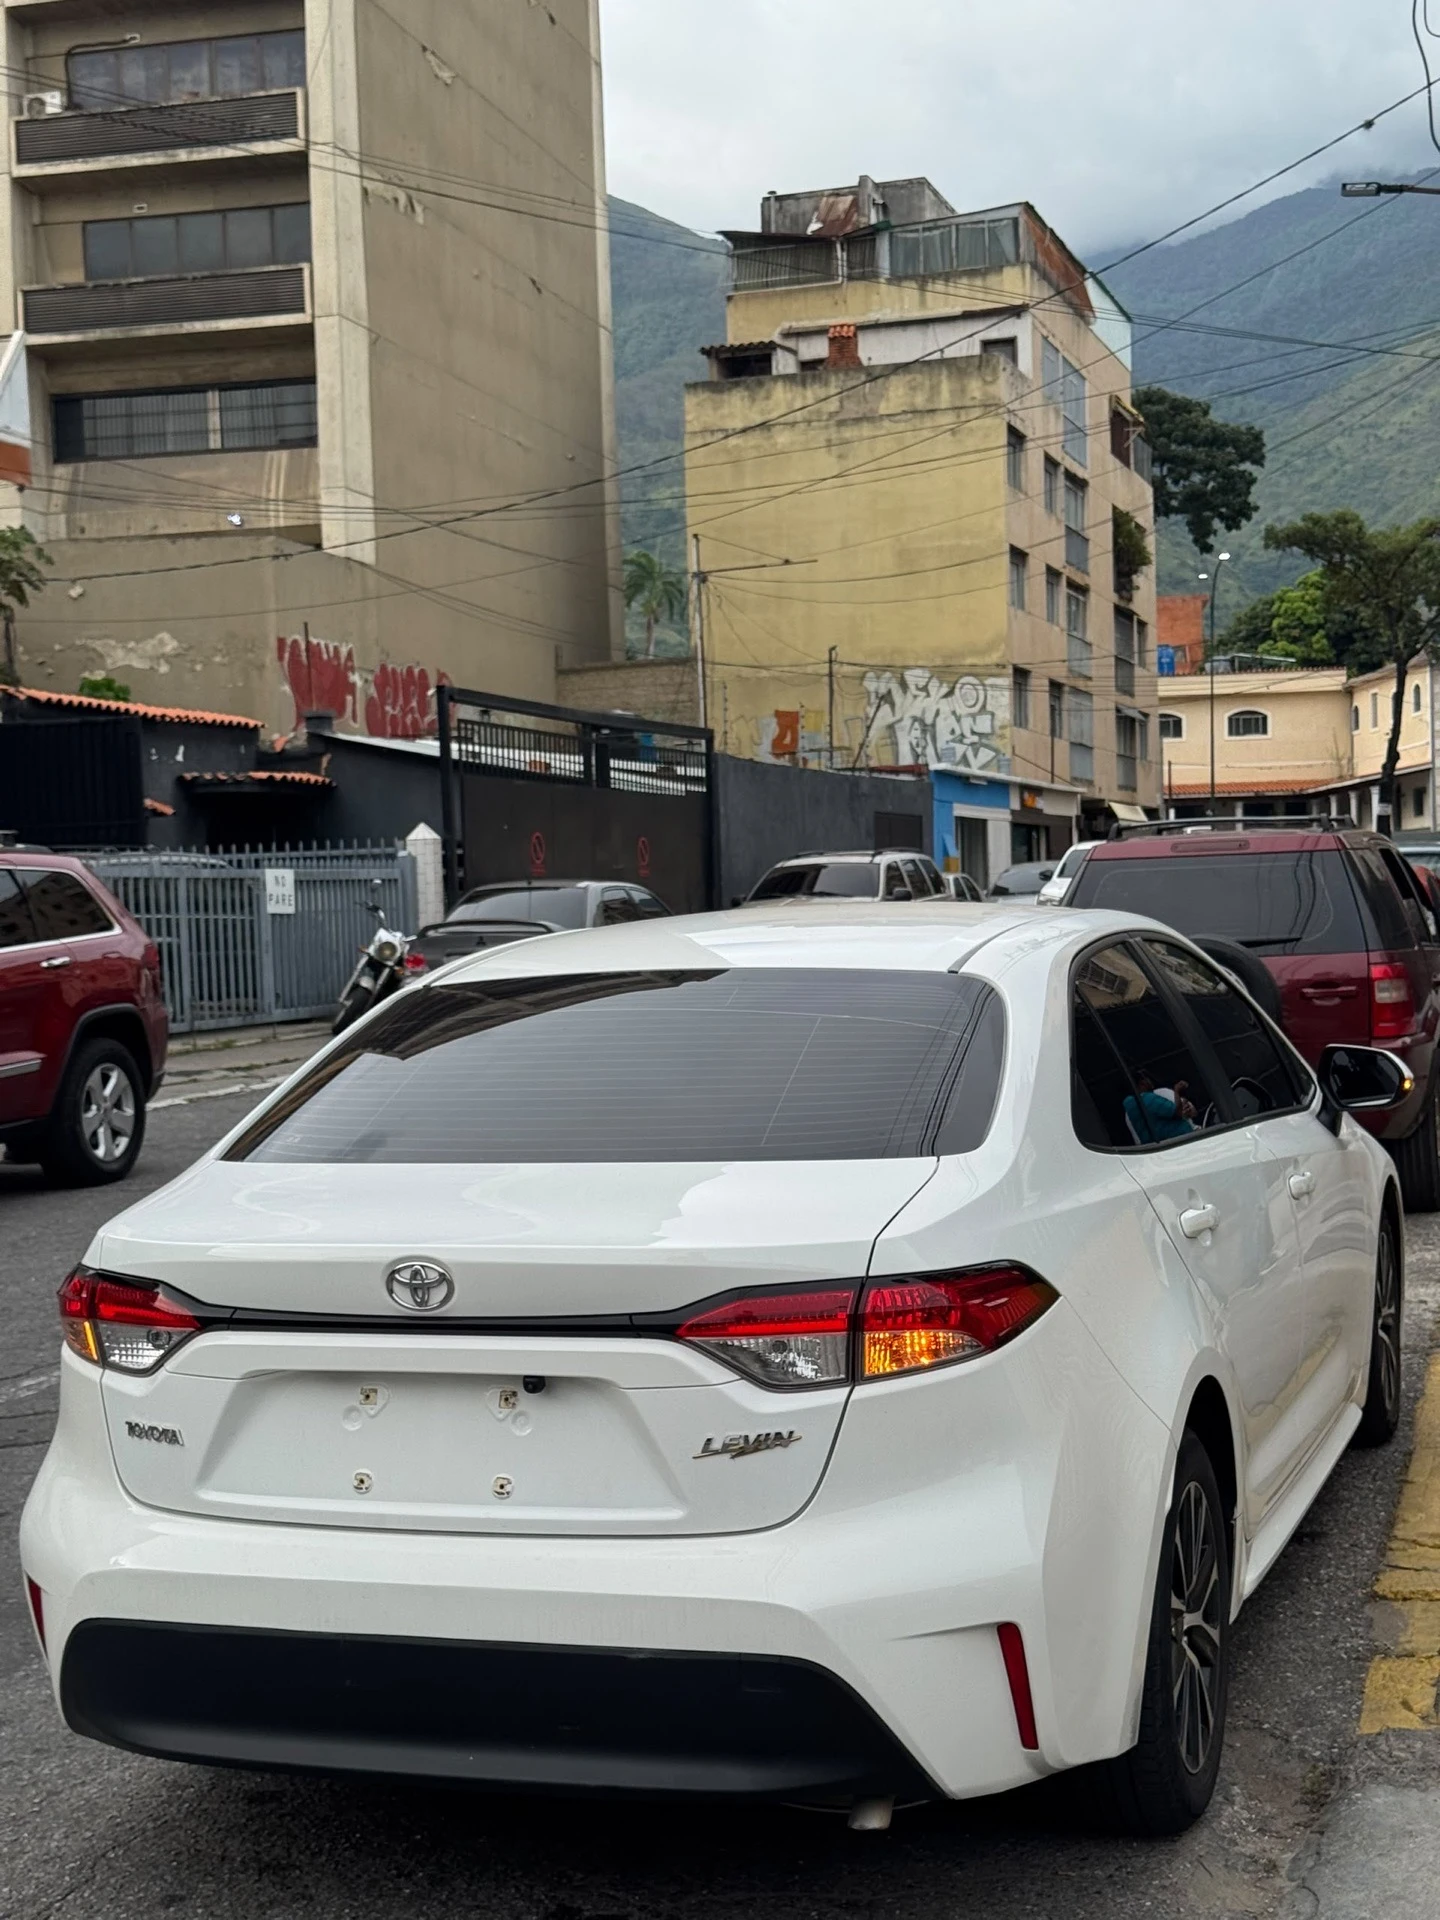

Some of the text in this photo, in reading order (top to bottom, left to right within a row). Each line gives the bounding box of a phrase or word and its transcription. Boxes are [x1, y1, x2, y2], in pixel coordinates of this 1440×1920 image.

[274, 875, 287, 888] NO
[268, 893, 294, 907] PARE
[125, 1421, 185, 1447] TOYOTA
[697, 1430, 798, 1456] LEVIN
